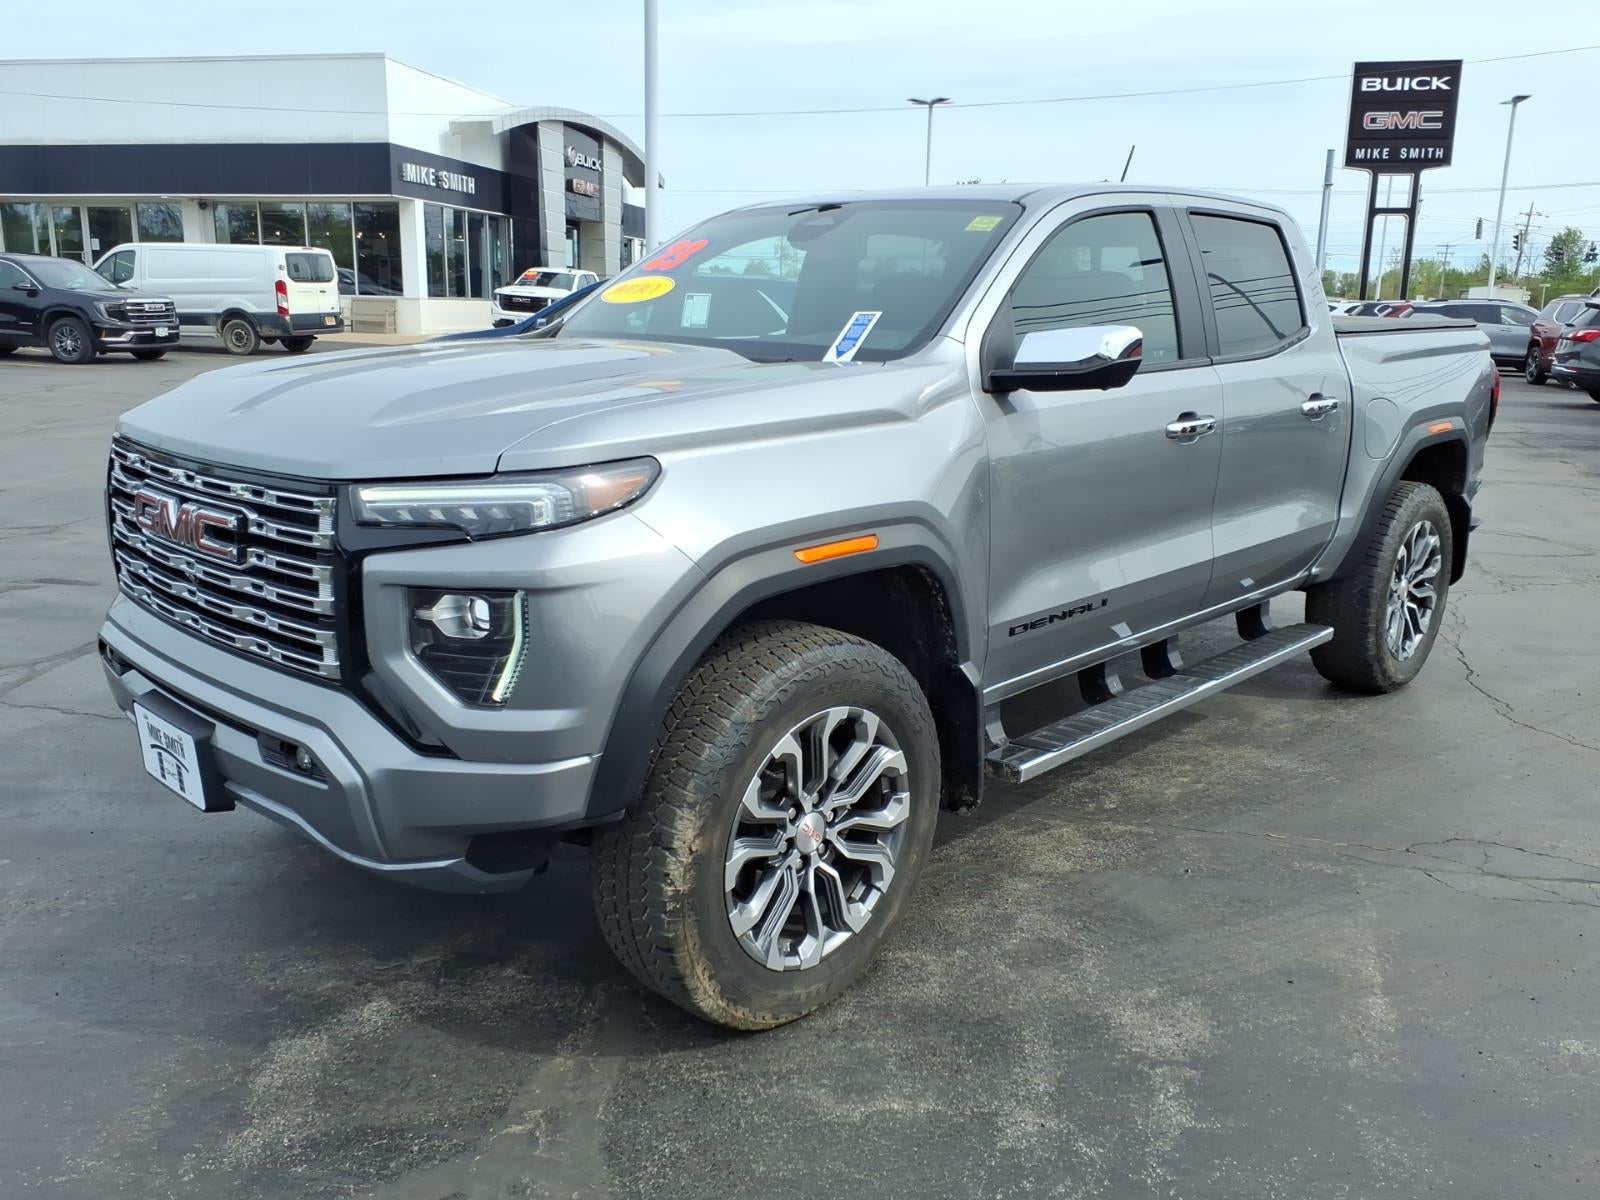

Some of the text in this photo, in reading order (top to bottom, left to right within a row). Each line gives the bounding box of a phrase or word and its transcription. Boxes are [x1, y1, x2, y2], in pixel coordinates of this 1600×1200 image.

[1361, 76, 1452, 91] BUICK
[1363, 110, 1444, 129] GMC
[575, 153, 602, 171] BUICK
[1355, 147, 1444, 159] MIKE SMITH
[404, 163, 475, 194] MIKE SMITH
[135, 488, 239, 562] GMC
[1008, 598, 1108, 637] DENALI
[147, 721, 186, 759] MIKE SMITH
